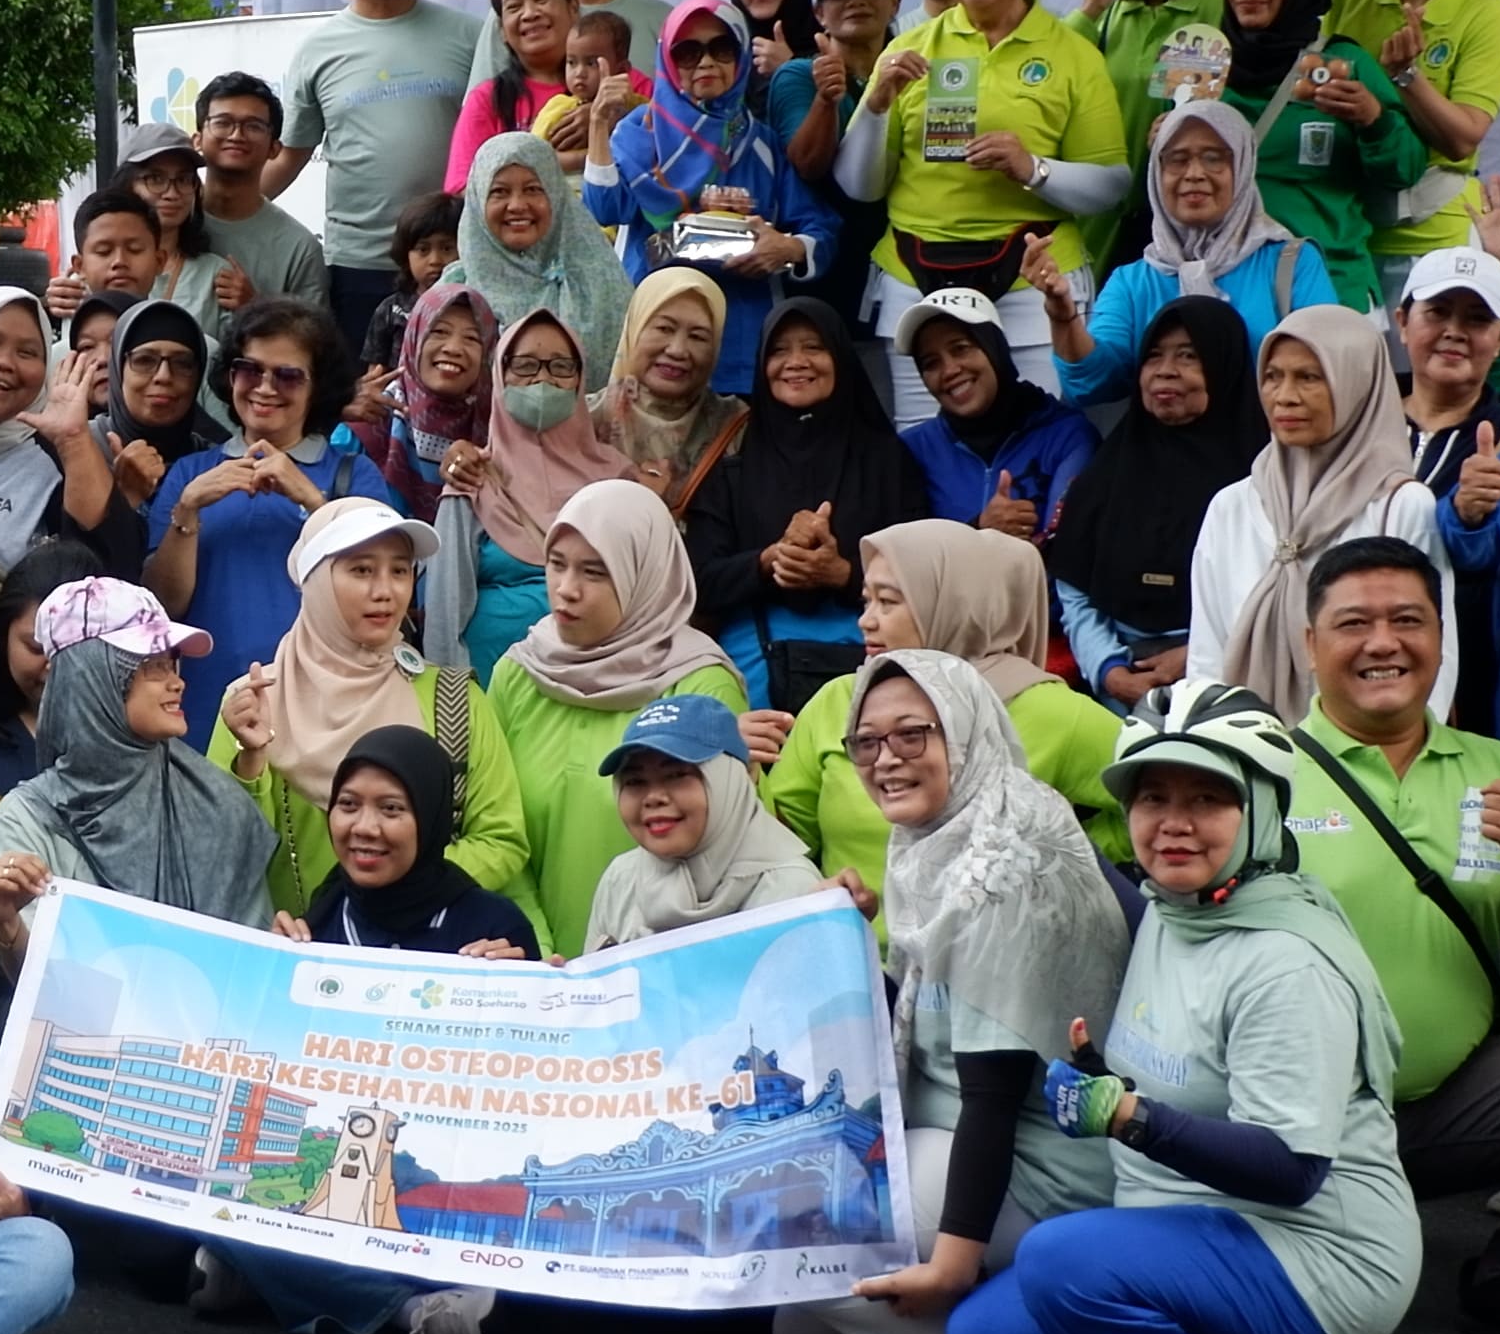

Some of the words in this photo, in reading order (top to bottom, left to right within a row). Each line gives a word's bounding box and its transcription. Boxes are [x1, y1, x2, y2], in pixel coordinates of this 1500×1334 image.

[450, 998, 474, 1008] RSO
[476, 998, 527, 1010] Soeharso
[385, 1020, 442, 1037] SENAM
[445, 1025, 493, 1039] SENDI
[510, 1028, 571, 1045] TULANG
[304, 1033, 393, 1067] HARI
[401, 1046, 663, 1084] OSTEOPOROSIS
[181, 1043, 272, 1081] HARI
[276, 1064, 472, 1110] KESEHATAN
[481, 1085, 658, 1119] NASIONAL
[667, 1073, 755, 1114] KE-61
[493, 1121, 528, 1134] 2025
[28, 1158, 85, 1184] mandiri
[236, 1212, 251, 1224] pt.
[255, 1217, 283, 1229] tiara
[286, 1222, 335, 1238] kencana
[364, 1233, 431, 1258] Phapros
[459, 1249, 524, 1269] ENDO
[810, 1263, 847, 1276] KALBE
